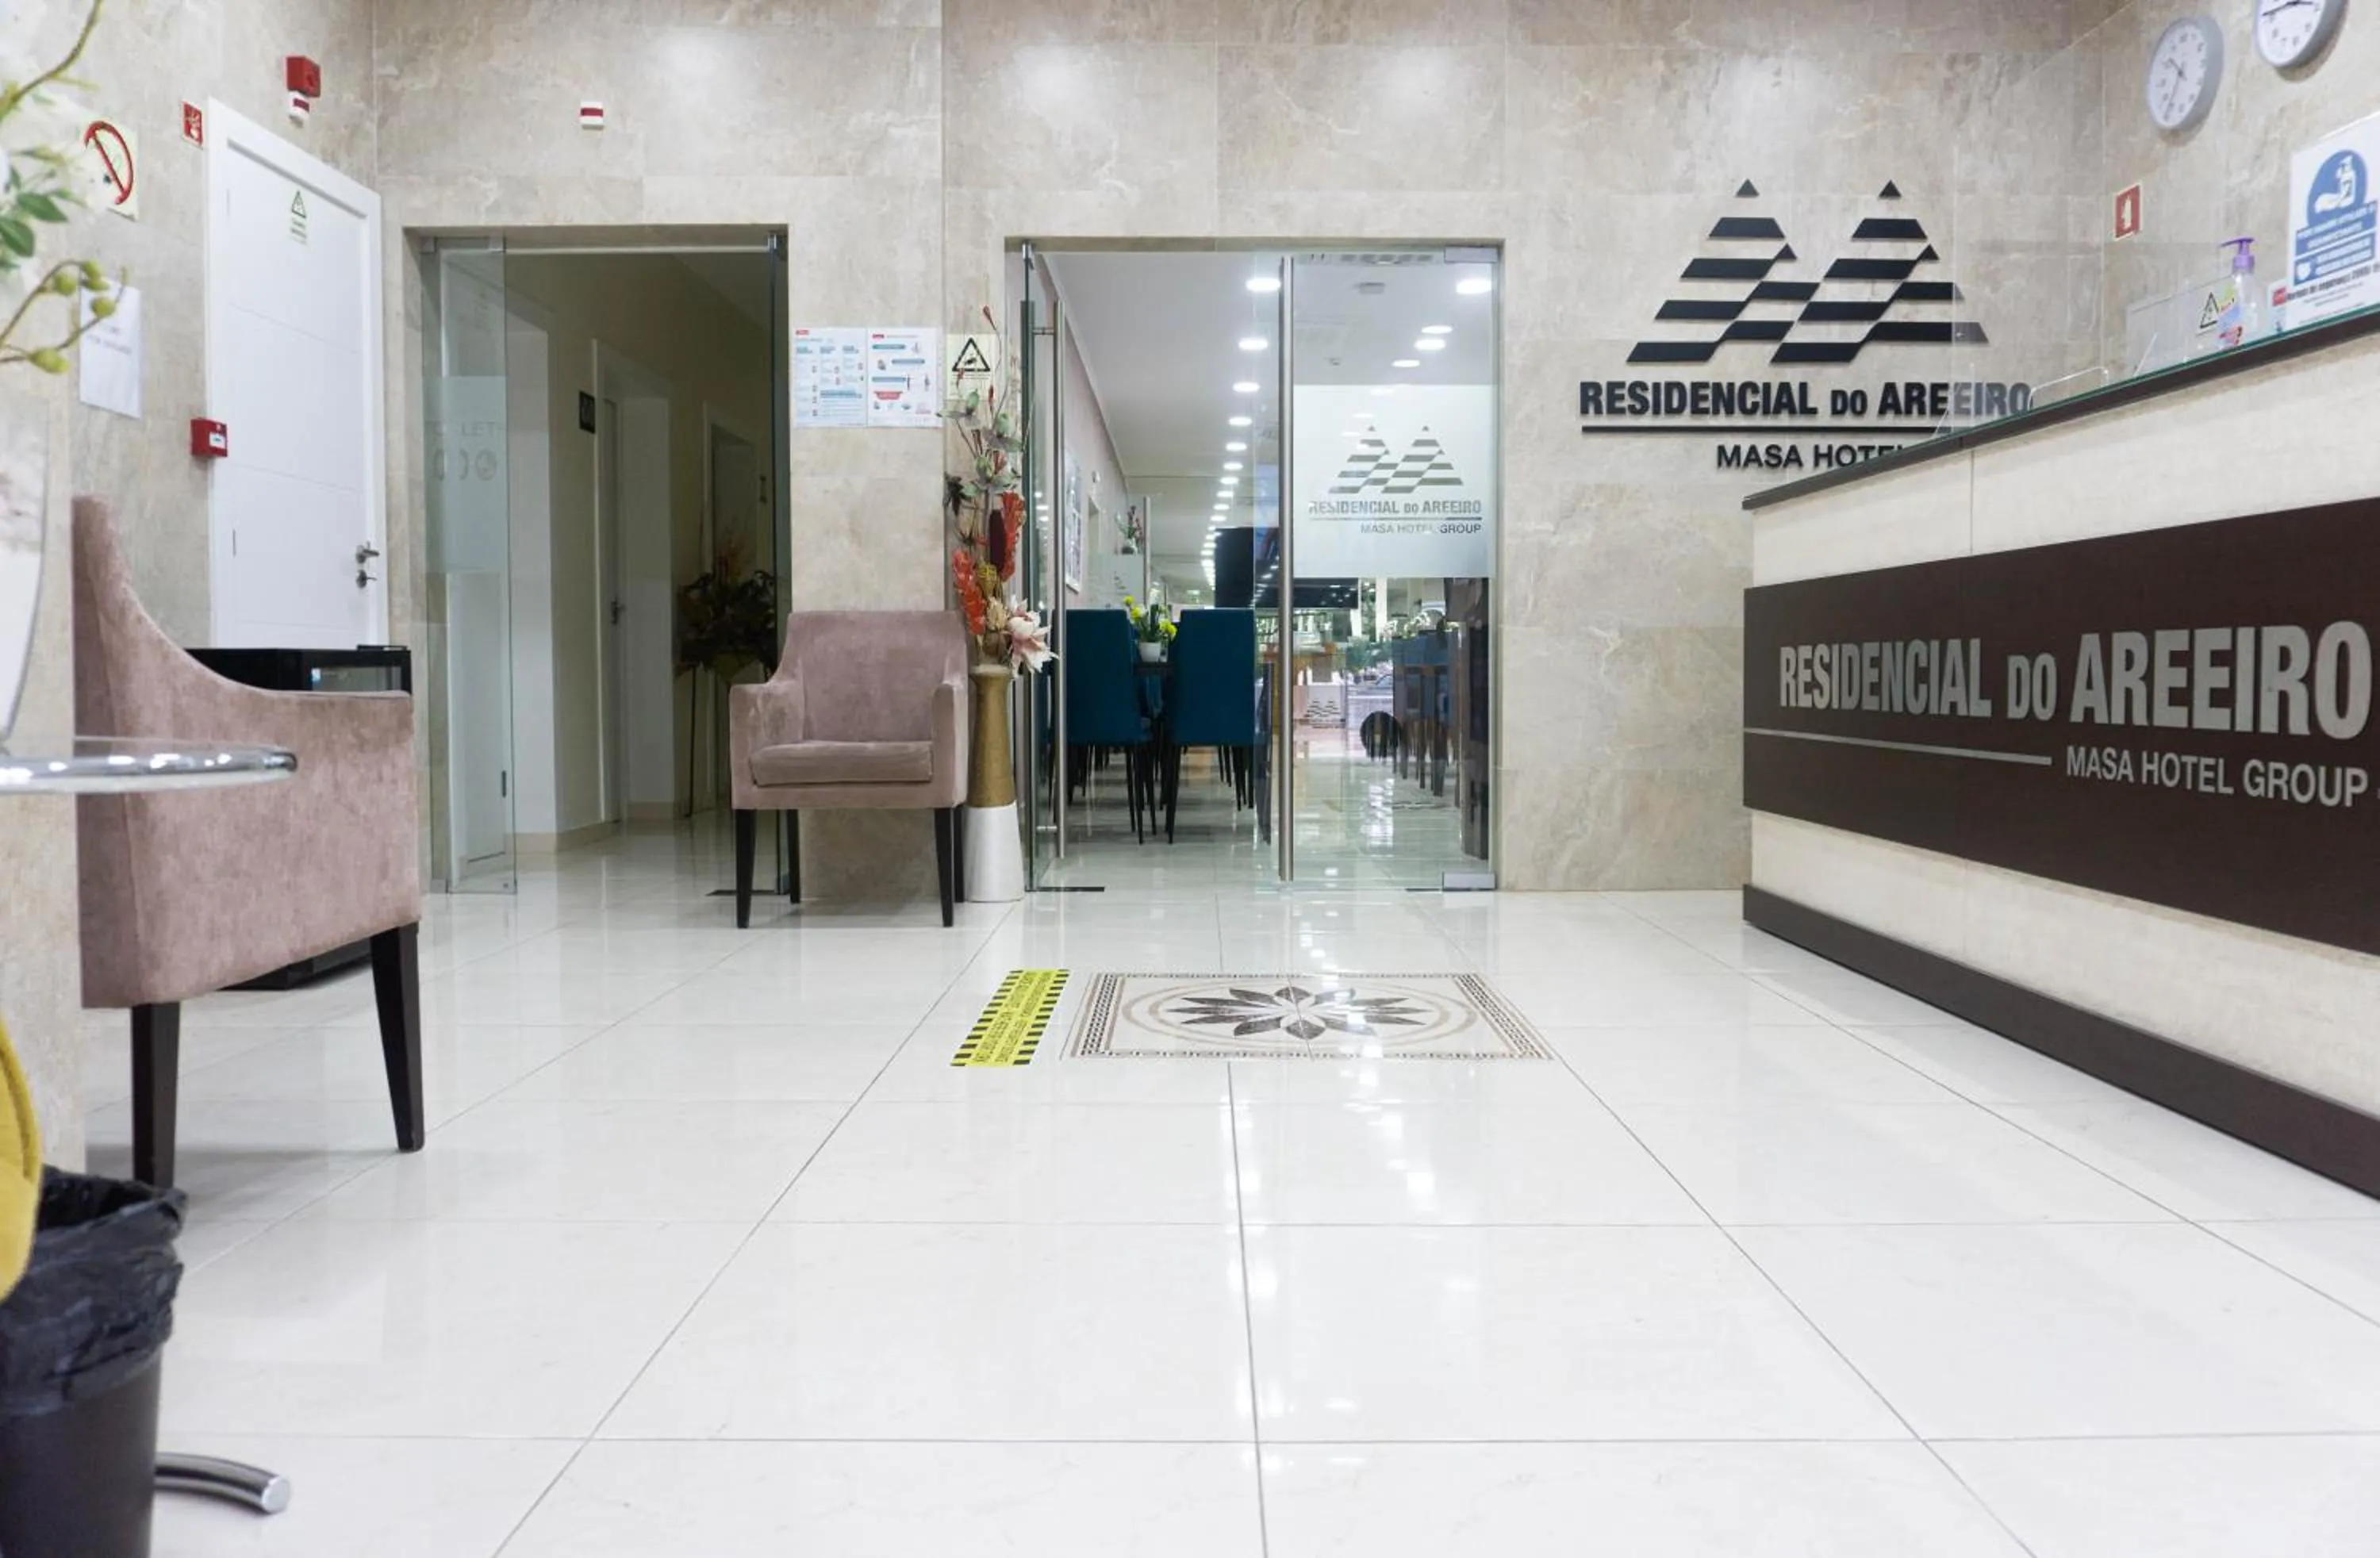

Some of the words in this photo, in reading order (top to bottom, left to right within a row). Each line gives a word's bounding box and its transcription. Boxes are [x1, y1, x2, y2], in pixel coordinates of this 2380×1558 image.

[1580, 381, 1818, 416] RESIDENCIAL
[1829, 389, 1868, 416] DO
[1877, 382, 2033, 416] AREEIRO
[1717, 444, 1802, 469] MASA
[1814, 444, 1903, 467] HOT
[1309, 501, 1399, 515] RESIDENCIAL
[1404, 502, 1419, 515] DO
[1422, 500, 1482, 514] AREEIRO
[1361, 524, 1394, 534] MASA
[1439, 524, 1482, 534] GROUP
[1779, 638, 1992, 718] RESIDENCIAL
[2007, 653, 2057, 720] DO
[2070, 621, 2372, 739] AREEIRO
[2067, 746, 2135, 783] MASA
[2141, 752, 2234, 796] HOTEL
[2243, 759, 2369, 808] GROUP
